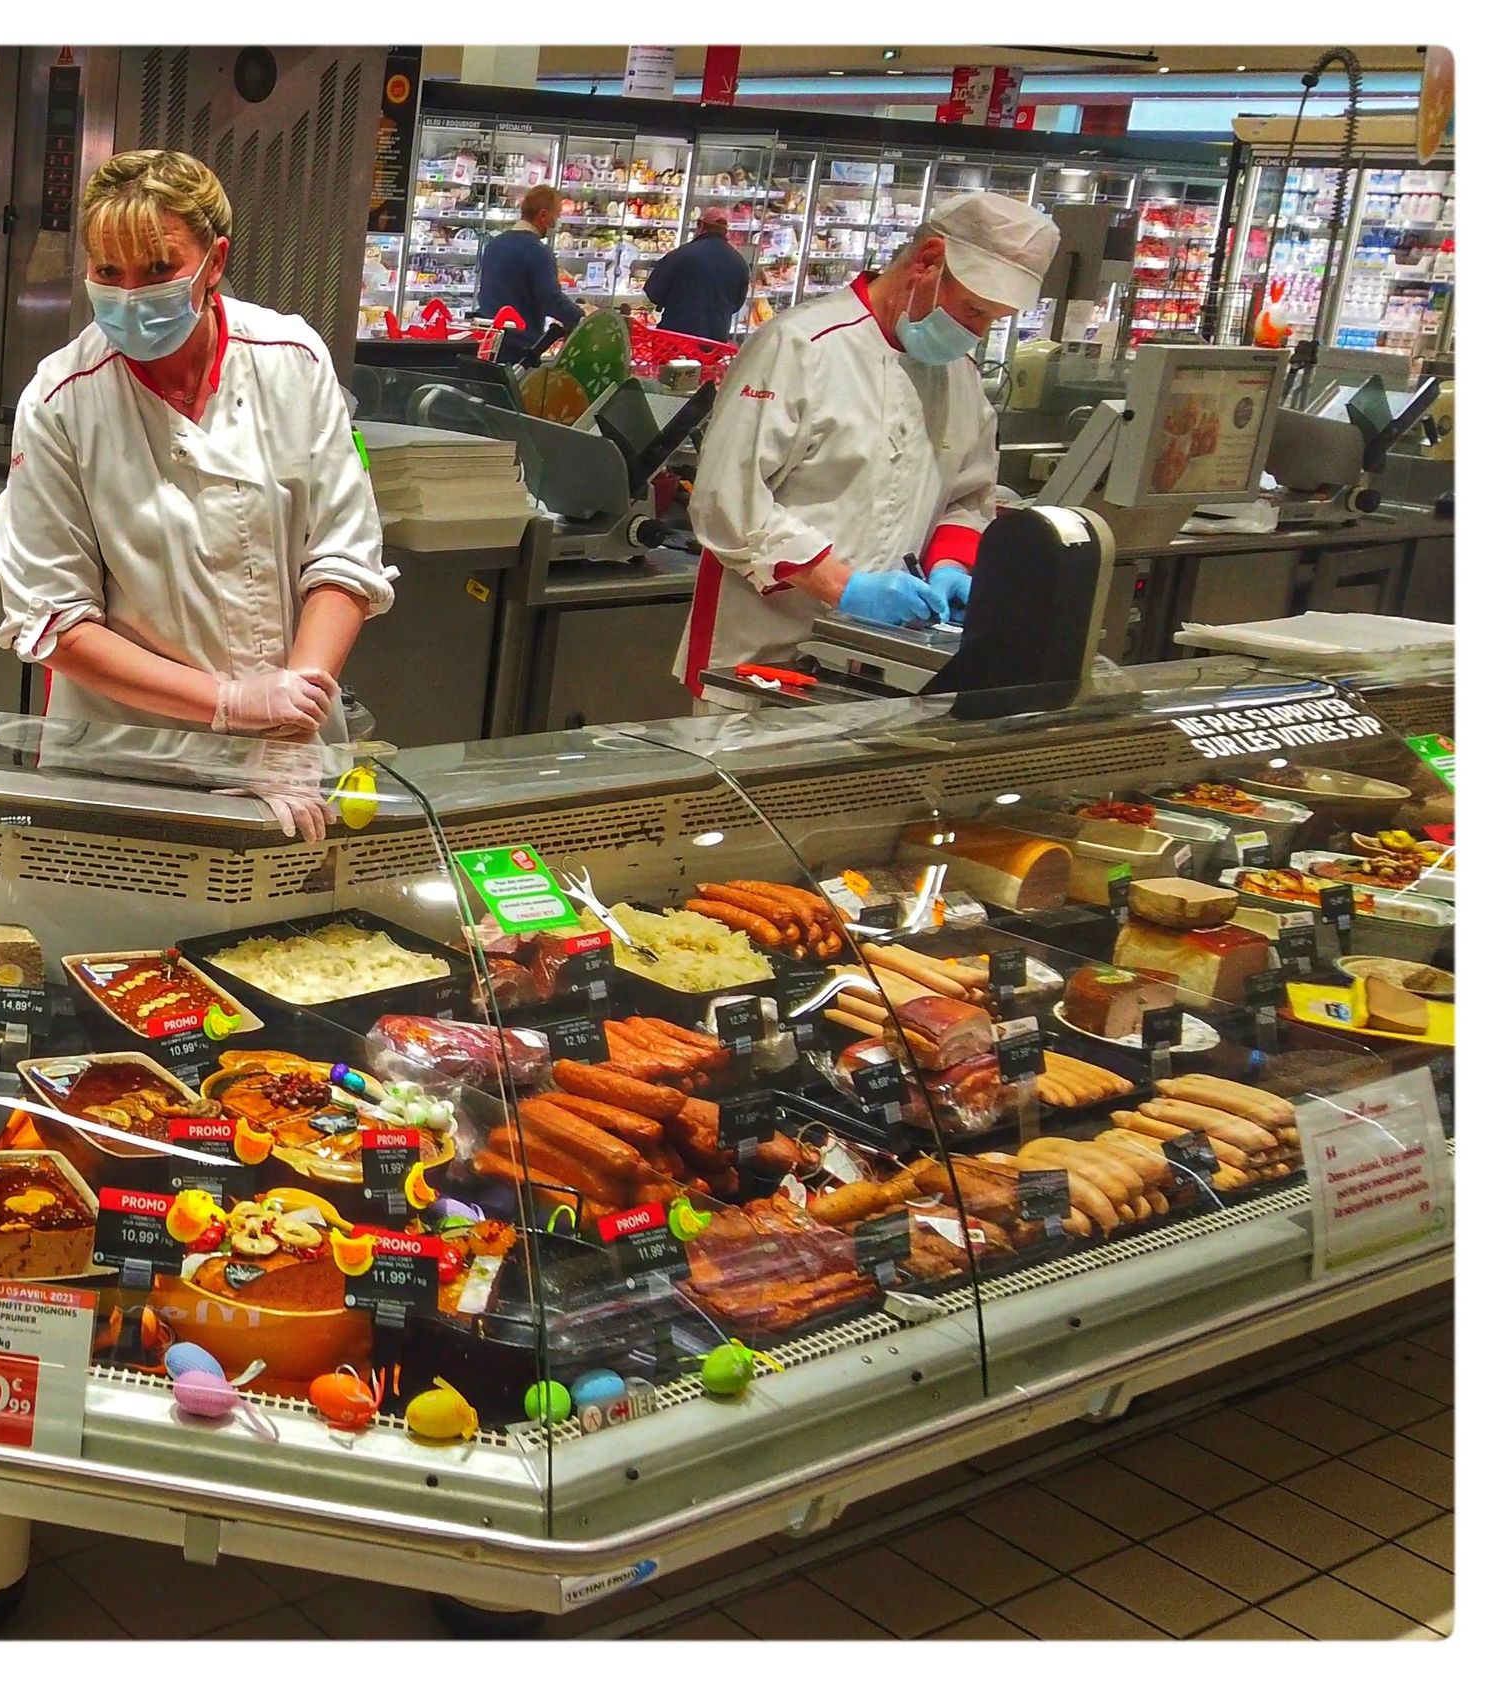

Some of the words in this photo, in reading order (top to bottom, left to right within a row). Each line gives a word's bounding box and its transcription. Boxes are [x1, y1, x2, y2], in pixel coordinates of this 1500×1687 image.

[445, 119, 481, 129] ROQUEFORT
[1171, 716, 1211, 737] NE
[1205, 711, 1256, 733] PAS
[1243, 698, 1360, 728] S'APPUYER
[1190, 734, 1246, 759] SUR
[1234, 728, 1282, 753] LES
[1271, 720, 1351, 747] VITRES
[1338, 715, 1384, 738] SVP
[576, 937, 601, 949] PROMO
[163, 1015, 198, 1031] PROMO
[169, 1040, 198, 1057] 10,99€
[188, 1125, 231, 1137] PROMO
[376, 1134, 407, 1146] PROMO
[121, 1195, 167, 1212] PROMO
[615, 1211, 651, 1232] PROMO
[121, 1228, 160, 1244] 10,99€
[372, 1269, 412, 1285] 11,99€
[6, 1286, 19, 1297] 05
[19, 1288, 48, 1301] AVRIL
[49, 1291, 74, 1303] 2021
[0, 1311, 37, 1325] PRUNIER
[24, 1303, 78, 1318] D'OIGNONS
